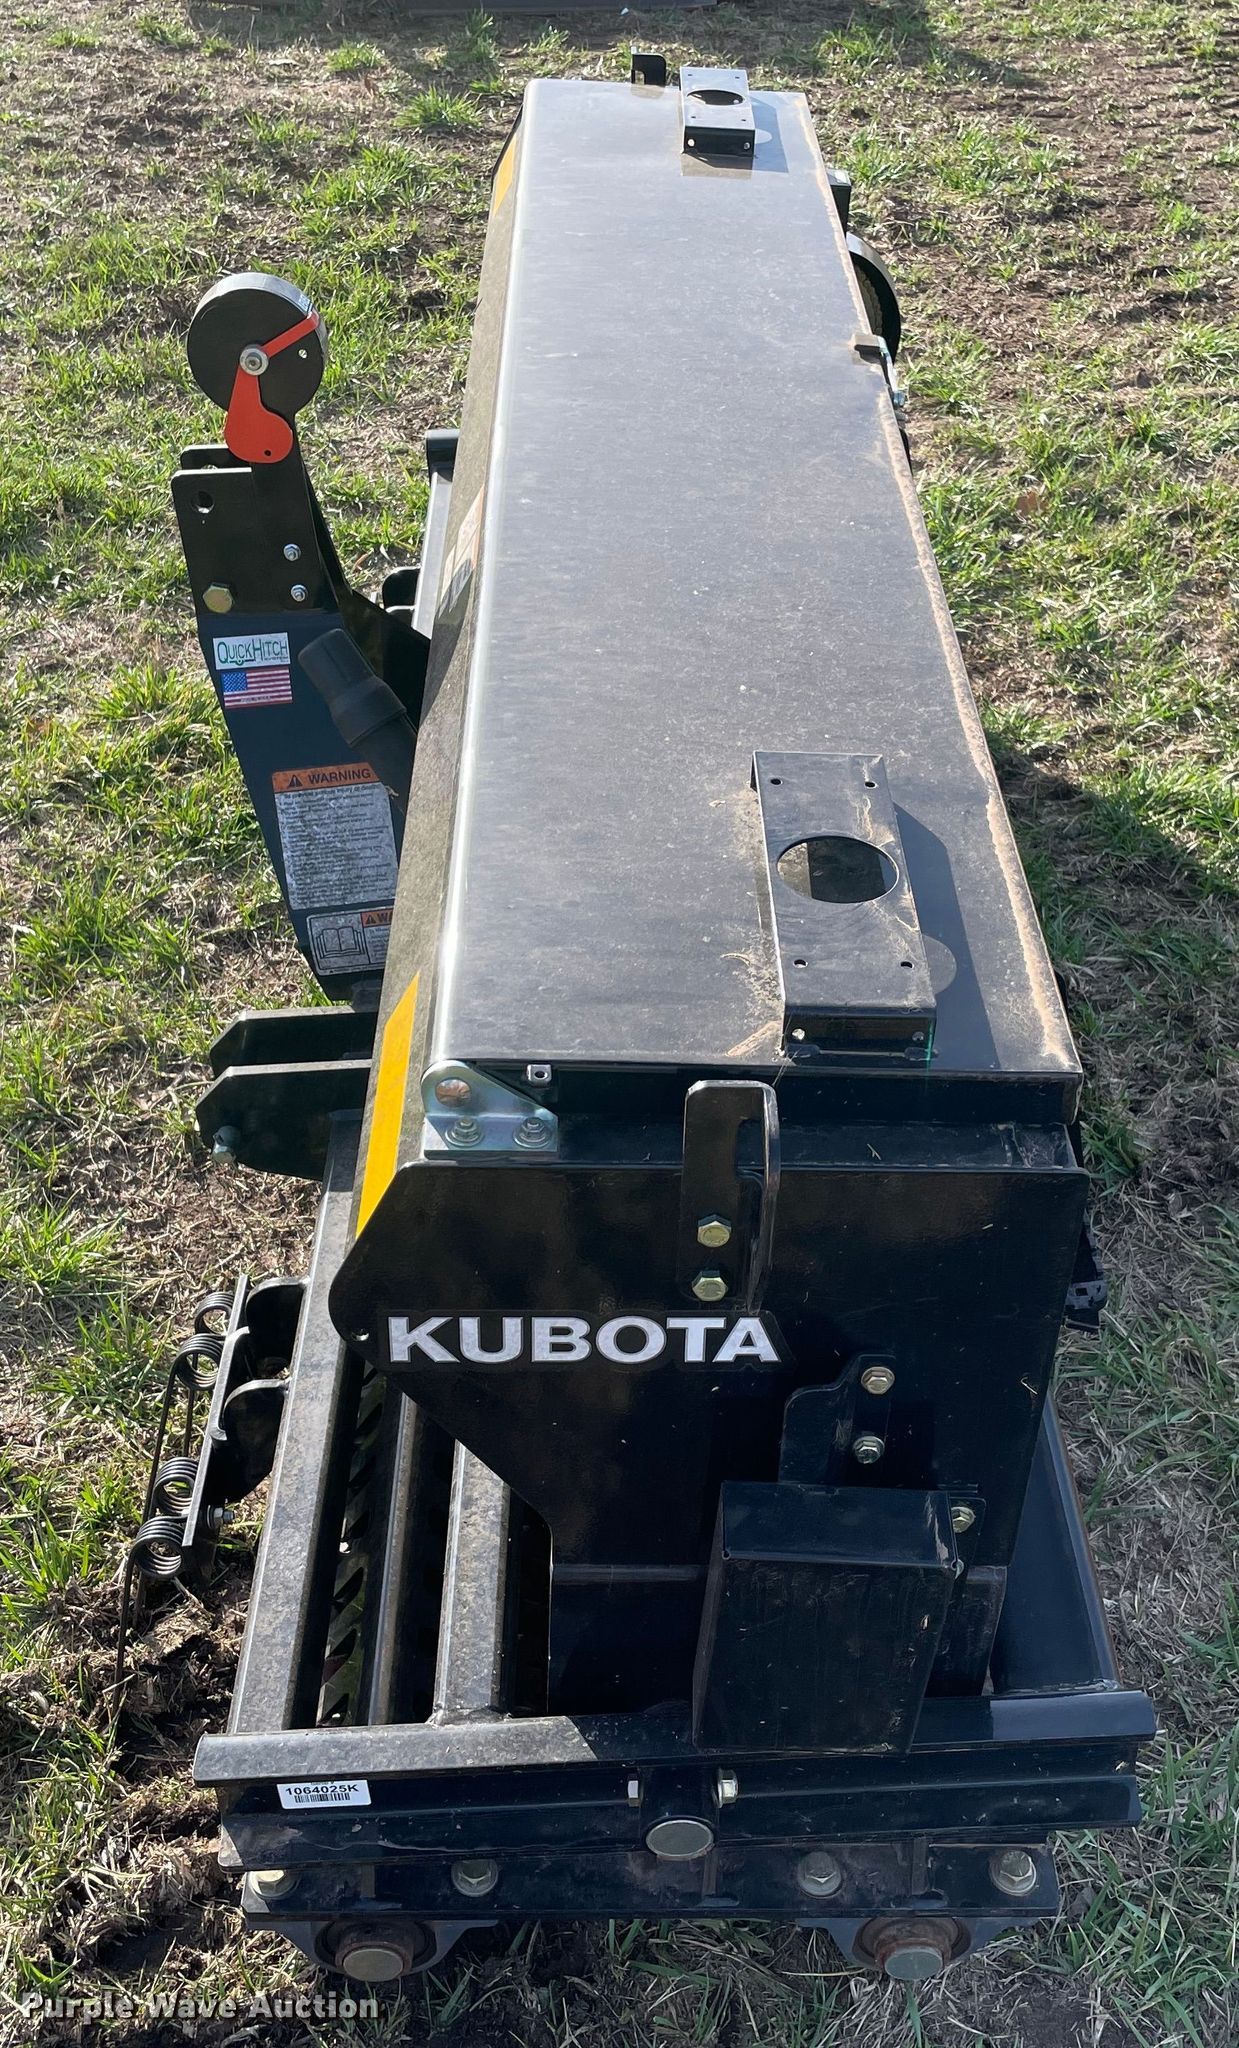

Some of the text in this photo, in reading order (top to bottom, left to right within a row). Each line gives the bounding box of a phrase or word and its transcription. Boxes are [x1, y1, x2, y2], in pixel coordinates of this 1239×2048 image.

[308, 768, 371, 784] WARNING
[388, 1315, 782, 1364] KUBOTA
[286, 1784, 359, 1796] 1064025K
